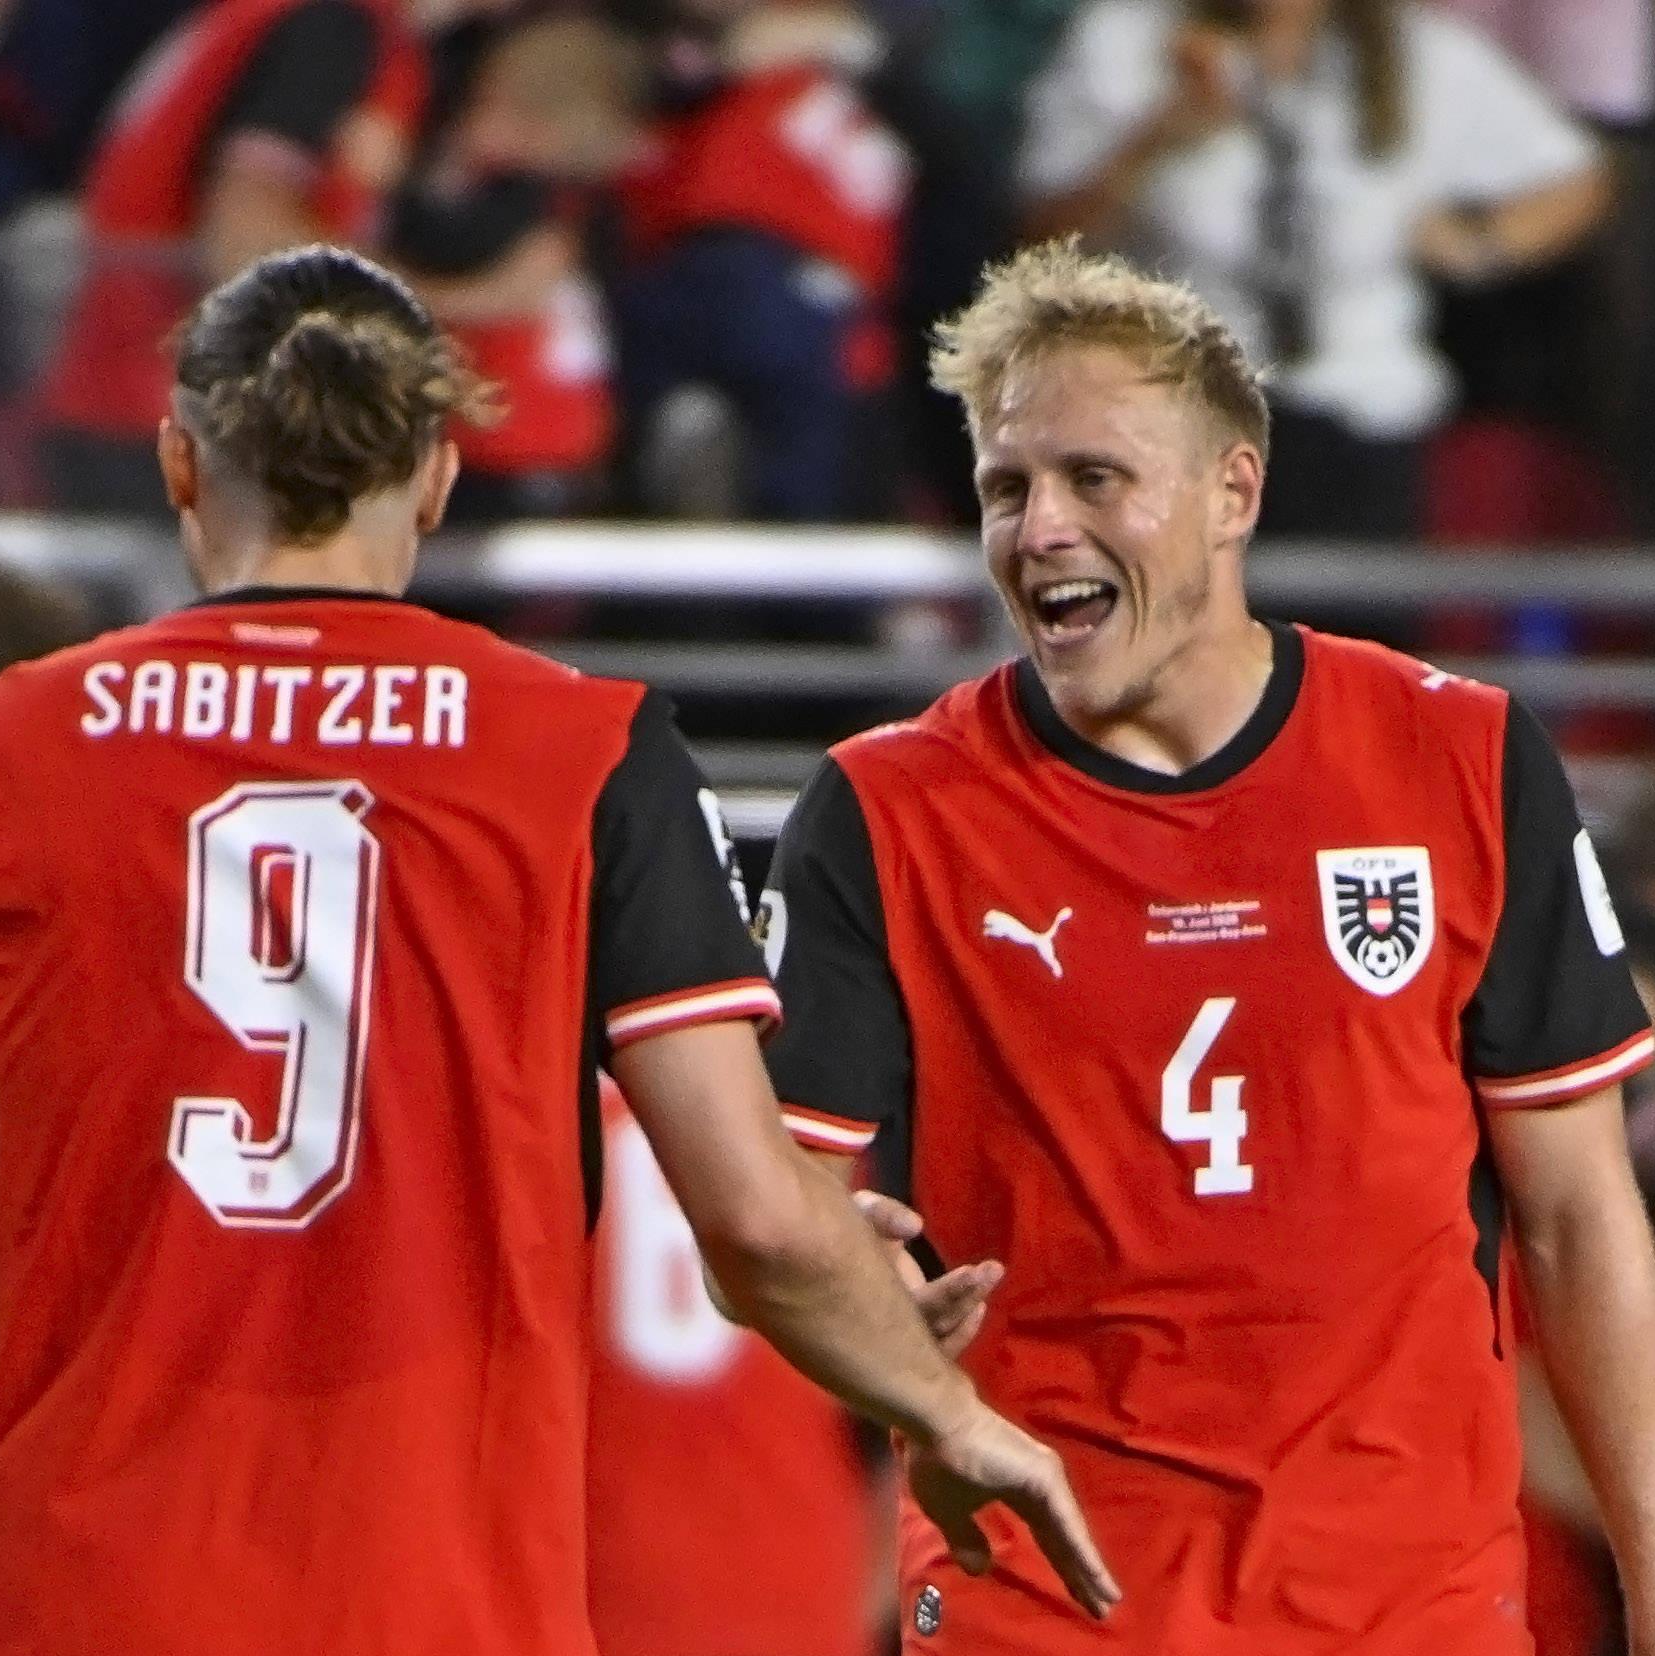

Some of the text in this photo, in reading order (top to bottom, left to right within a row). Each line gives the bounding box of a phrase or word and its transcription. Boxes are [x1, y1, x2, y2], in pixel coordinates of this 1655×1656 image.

[80, 659, 469, 748] SABITZER
[167, 778, 380, 1228] 9
[1161, 997, 1253, 1196] 4
